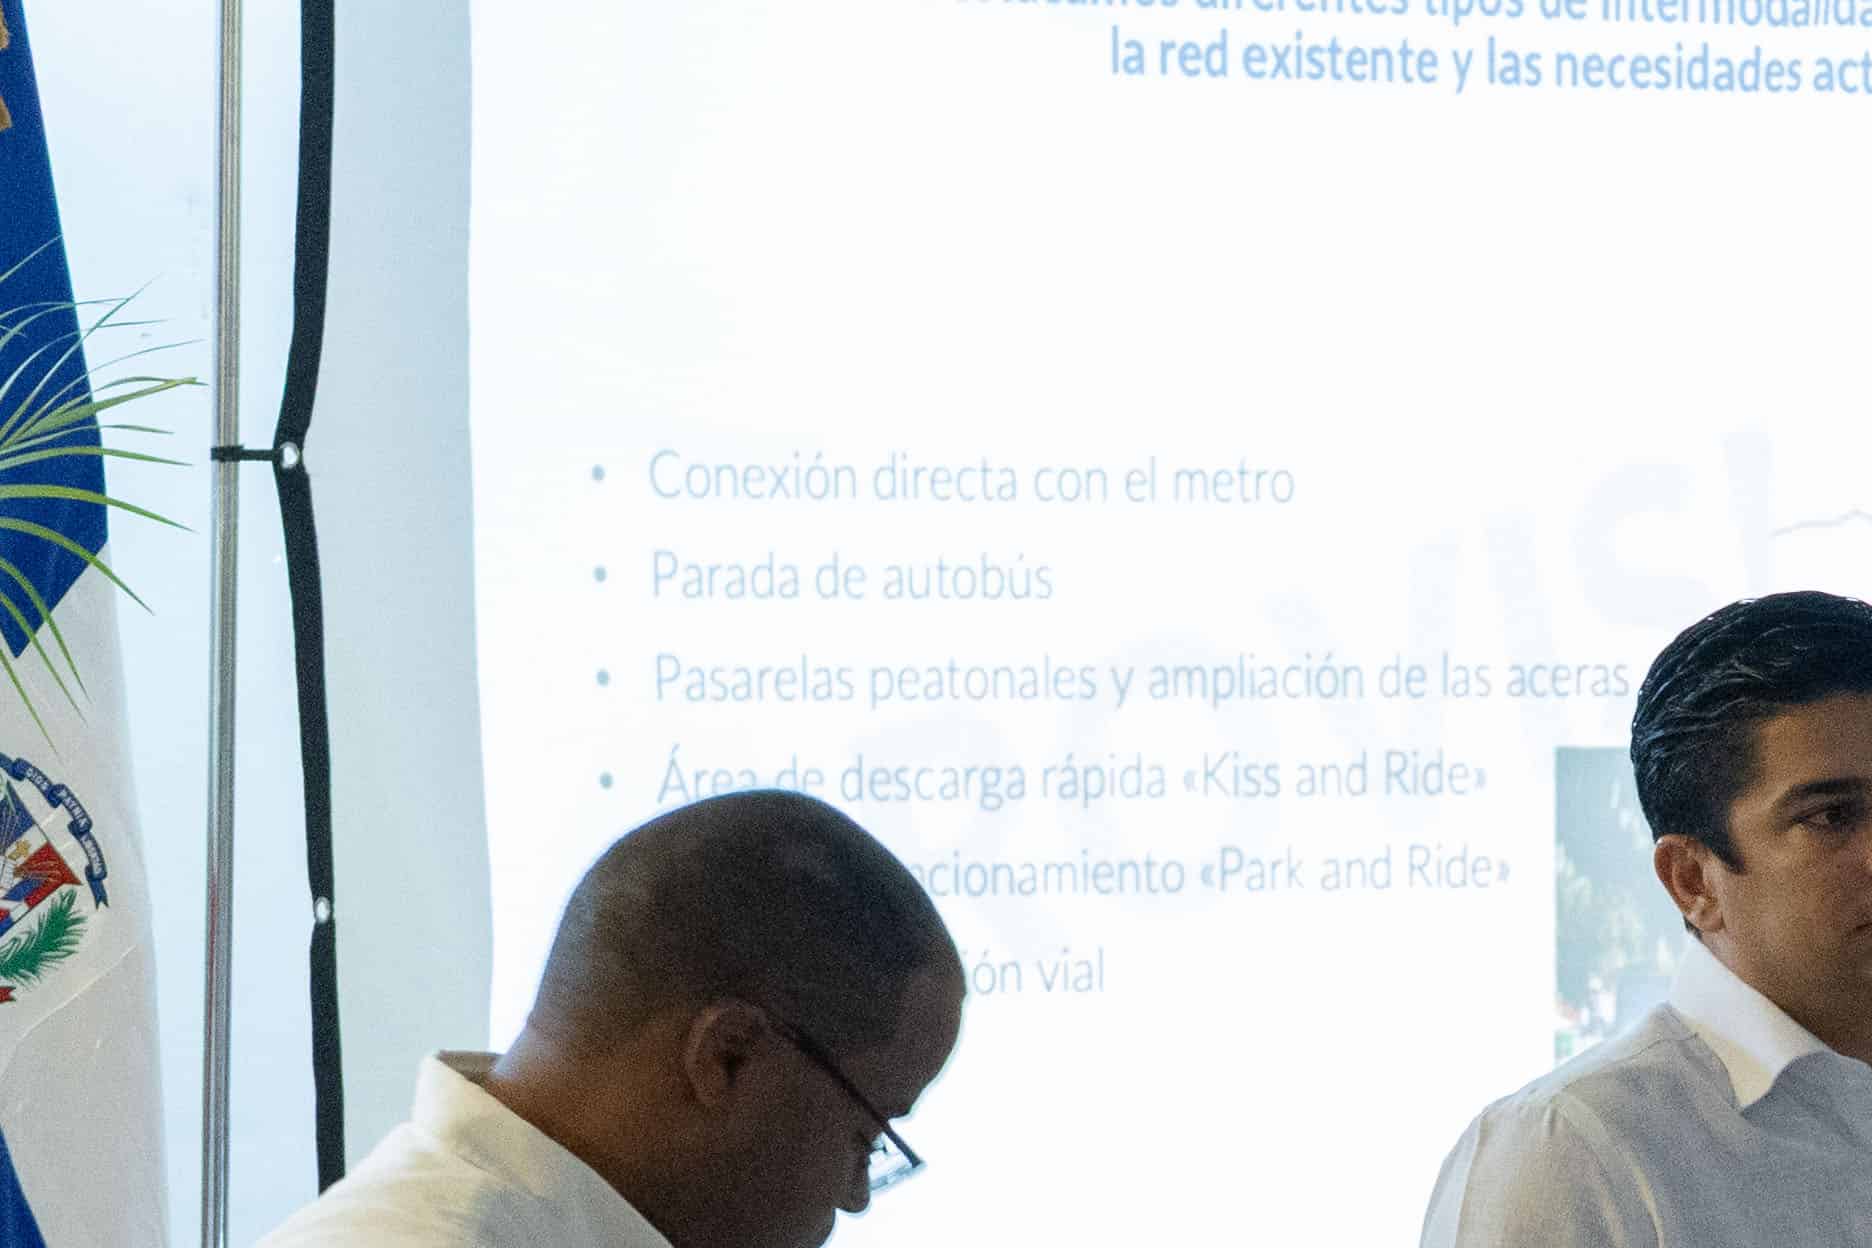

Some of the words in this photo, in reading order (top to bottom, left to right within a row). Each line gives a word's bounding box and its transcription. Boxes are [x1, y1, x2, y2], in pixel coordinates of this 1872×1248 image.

[1110, 22, 1147, 77] la
[1158, 25, 1230, 79] red
[1240, 28, 1440, 85] existente
[1450, 48, 1474, 96] y
[1486, 34, 1544, 88] las
[1554, 40, 1804, 95] necesidades
[647, 447, 858, 502] Conexión
[872, 450, 1018, 502] directa
[1033, 466, 1108, 503] con
[1124, 456, 1156, 503] el
[1173, 458, 1295, 504] metro
[652, 548, 800, 601] Parada
[814, 551, 867, 601] de
[882, 552, 1054, 601] autobús
[655, 651, 855, 704] Pasarelas
[869, 655, 1098, 710] peatonales
[1108, 664, 1136, 711] y
[1148, 652, 1364, 710] ampliación
[1378, 654, 1428, 700] de
[1440, 649, 1492, 698] las
[1506, 662, 1630, 698] aceras
[840, 754, 1026, 811] descarga
[1041, 752, 1167, 806] rápida
[1183, 750, 1281, 800] «Kiss
[1296, 747, 1370, 798] and
[1382, 748, 1487, 800] Ride»
[1198, 844, 1304, 894] «Park
[1320, 845, 1392, 892] and
[1408, 843, 1511, 889] Ride»
[1034, 945, 1104, 993] vial
